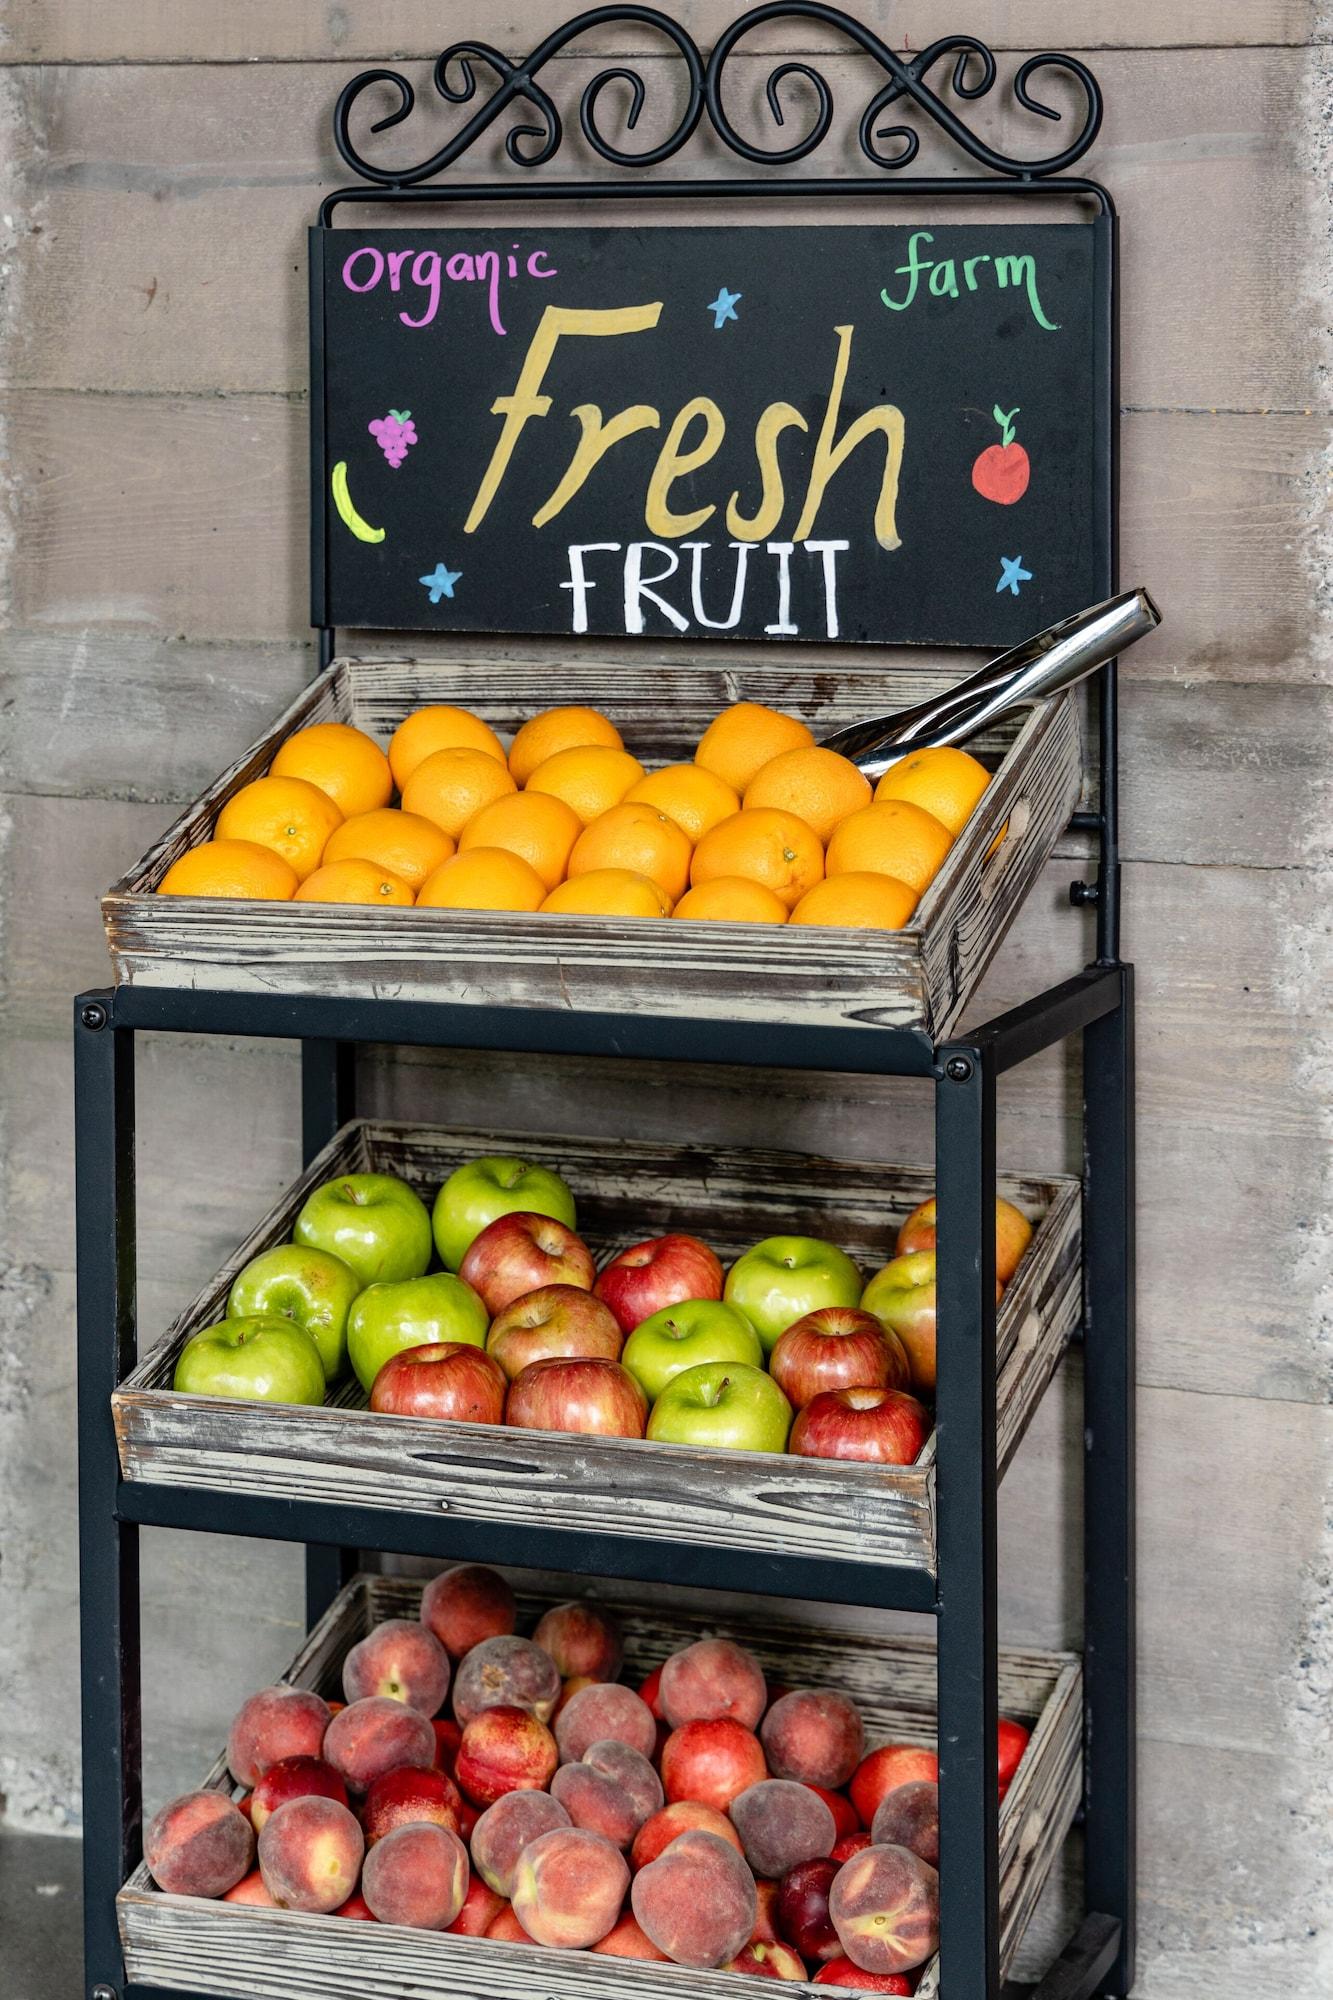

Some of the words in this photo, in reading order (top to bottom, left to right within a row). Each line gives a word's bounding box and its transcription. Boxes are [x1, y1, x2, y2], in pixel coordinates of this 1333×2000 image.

[880, 231, 1061, 331] farm
[463, 301, 907, 552] Fresh
[558, 538, 851, 639] FRUIT
